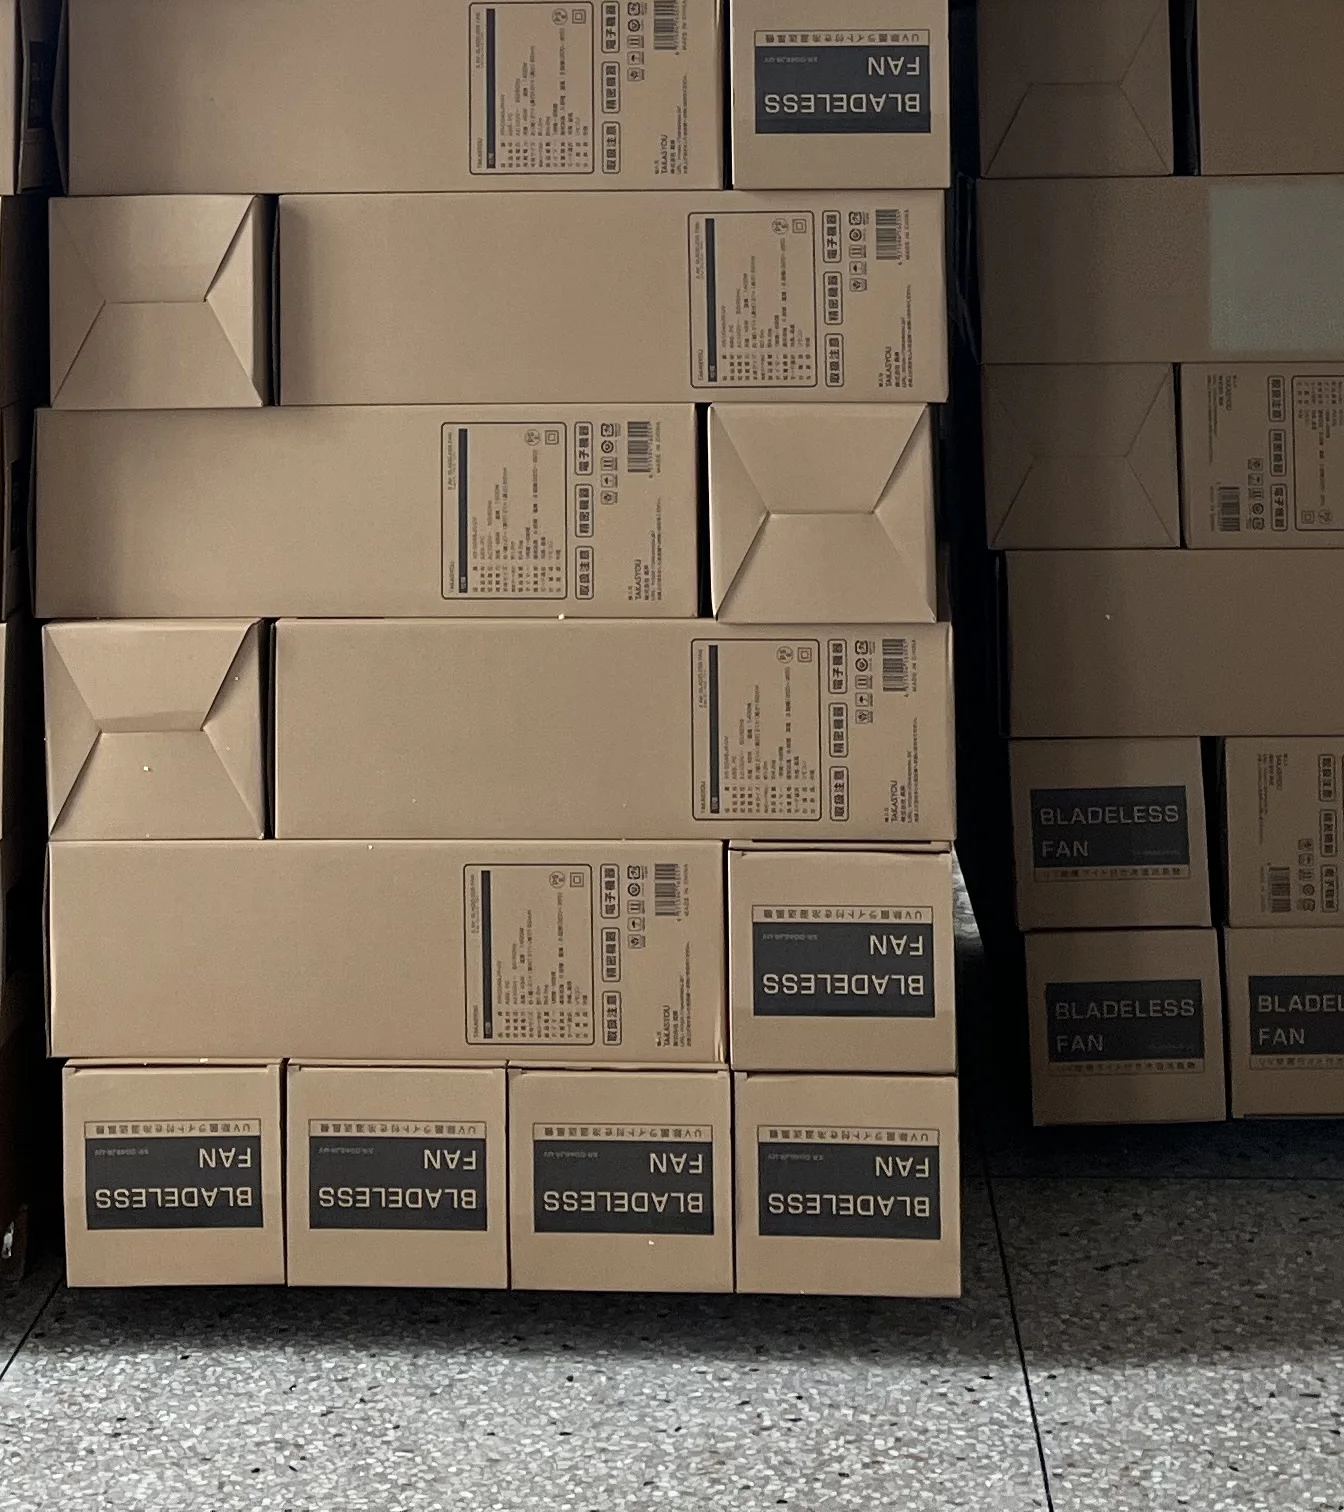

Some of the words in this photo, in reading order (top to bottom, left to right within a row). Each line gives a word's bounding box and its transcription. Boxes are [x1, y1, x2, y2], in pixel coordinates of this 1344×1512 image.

[606, 5, 616, 49] 電子機器
[869, 57, 919, 75] FAN
[765, 94, 919, 112] BLADELESS
[606, 126, 616, 170] 取扱注意
[827, 215, 837, 259] 電子機器
[829, 338, 839, 383] 取扱注意
[579, 426, 589, 471] 電子機器
[579, 550, 589, 595] 取扱注意
[833, 643, 843, 689] 電子機器
[834, 771, 844, 816] 取扱注意
[1041, 805, 1179, 824] BLADELESS
[1043, 841, 1088, 856] FAN
[605, 868, 616, 915] 電子機器
[870, 935, 922, 955] FAN
[763, 974, 923, 995] BLADELESS
[607, 996, 617, 1041] 取扱注意
[1057, 999, 1194, 1018] BLADELESS
[1057, 1035, 1103, 1051] FAN
[1259, 1028, 1304, 1045] FAN
[200, 1148, 251, 1167] FAN
[425, 1150, 476, 1169] FAN
[650, 1153, 702, 1173] FAN
[876, 1157, 928, 1177] FAN
[96, 1187, 251, 1208] BLADELESS
[319, 1187, 476, 1208] BLADELESS
[544, 1191, 702, 1212] BLADELESS
[769, 1194, 929, 1216] BLADELESS
